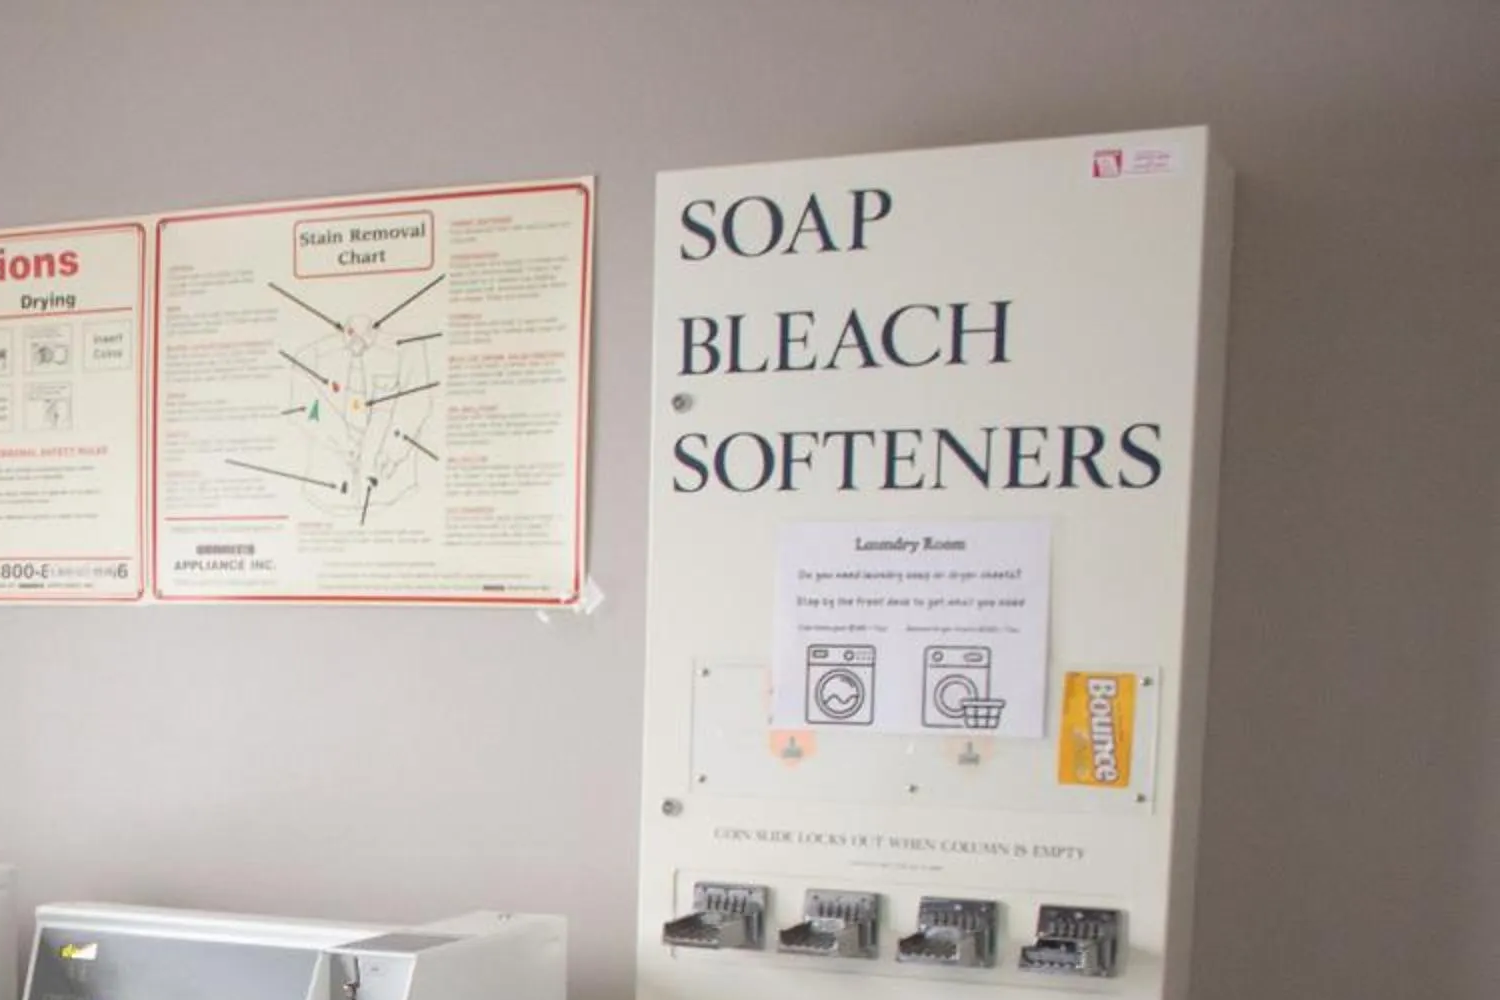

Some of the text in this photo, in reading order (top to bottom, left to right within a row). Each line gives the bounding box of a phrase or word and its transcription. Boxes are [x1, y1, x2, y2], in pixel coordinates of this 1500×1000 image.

[299, 229, 344, 247] Stain
[349, 221, 427, 243] Removal
[679, 188, 893, 261] SOAP
[337, 249, 387, 266] Chart
[20, 291, 77, 310] Drying
[677, 300, 1013, 377] BLEACH
[672, 423, 1163, 494] SOFTENERS
[855, 535, 966, 554] Laundry Room
[173, 558, 277, 572] APPLIANCE INC.
[1088, 678, 1118, 782] Bounce
